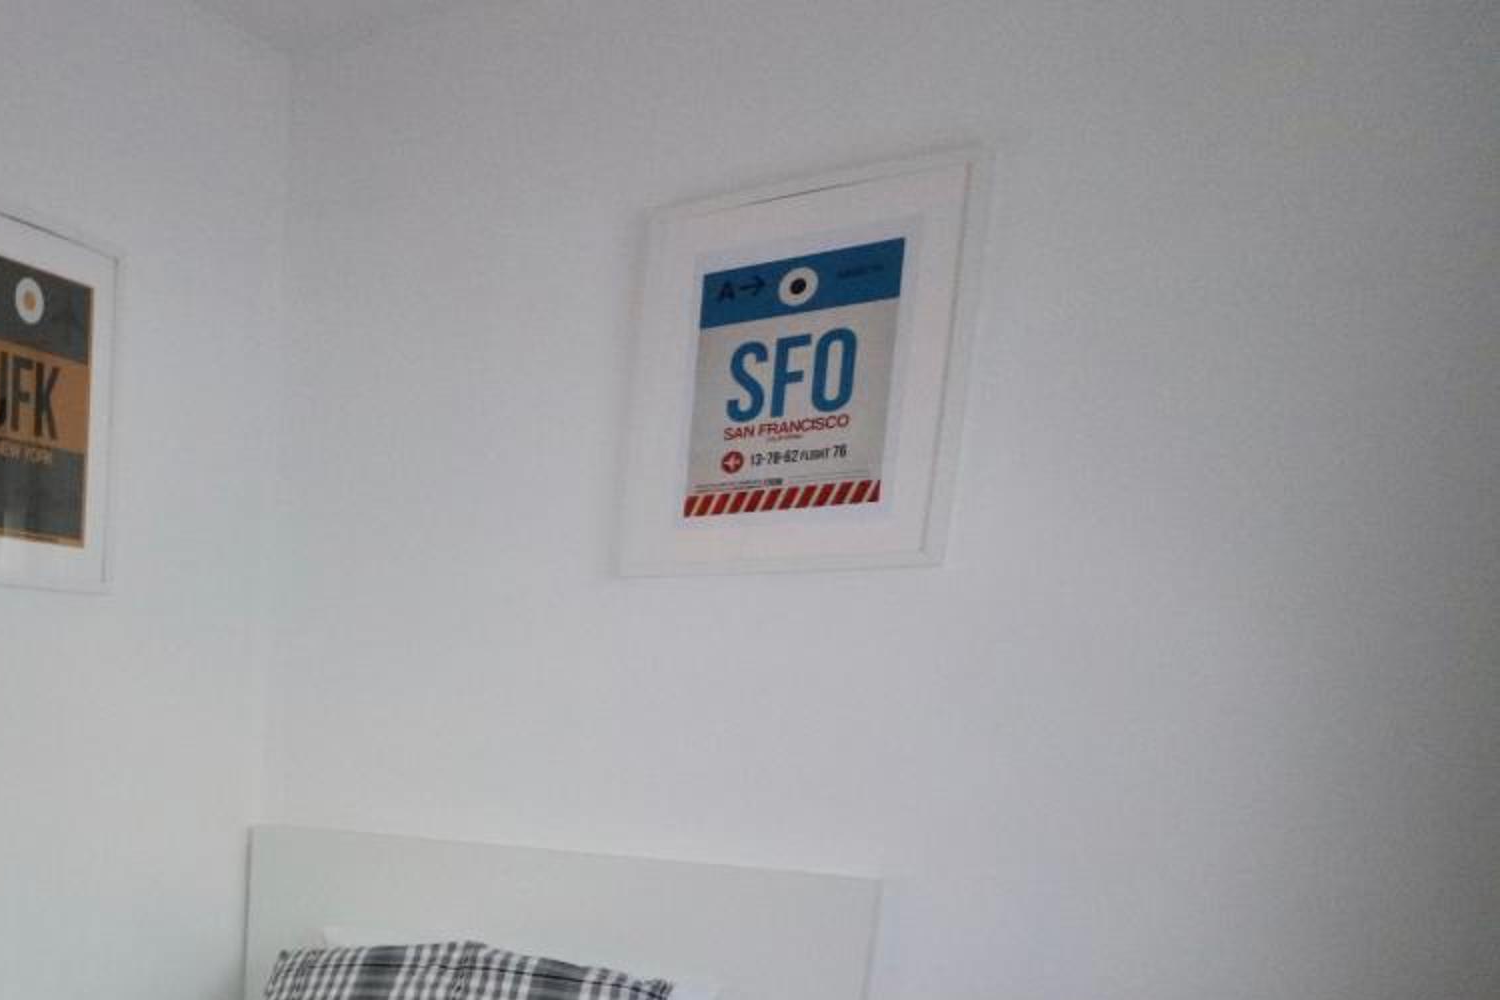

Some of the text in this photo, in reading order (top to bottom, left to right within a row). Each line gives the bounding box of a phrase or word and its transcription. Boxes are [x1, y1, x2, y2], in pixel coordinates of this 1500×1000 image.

[726, 327, 857, 423] SFO
[724, 426, 755, 441] SAN
[758, 413, 850, 435] FRANCISCO
